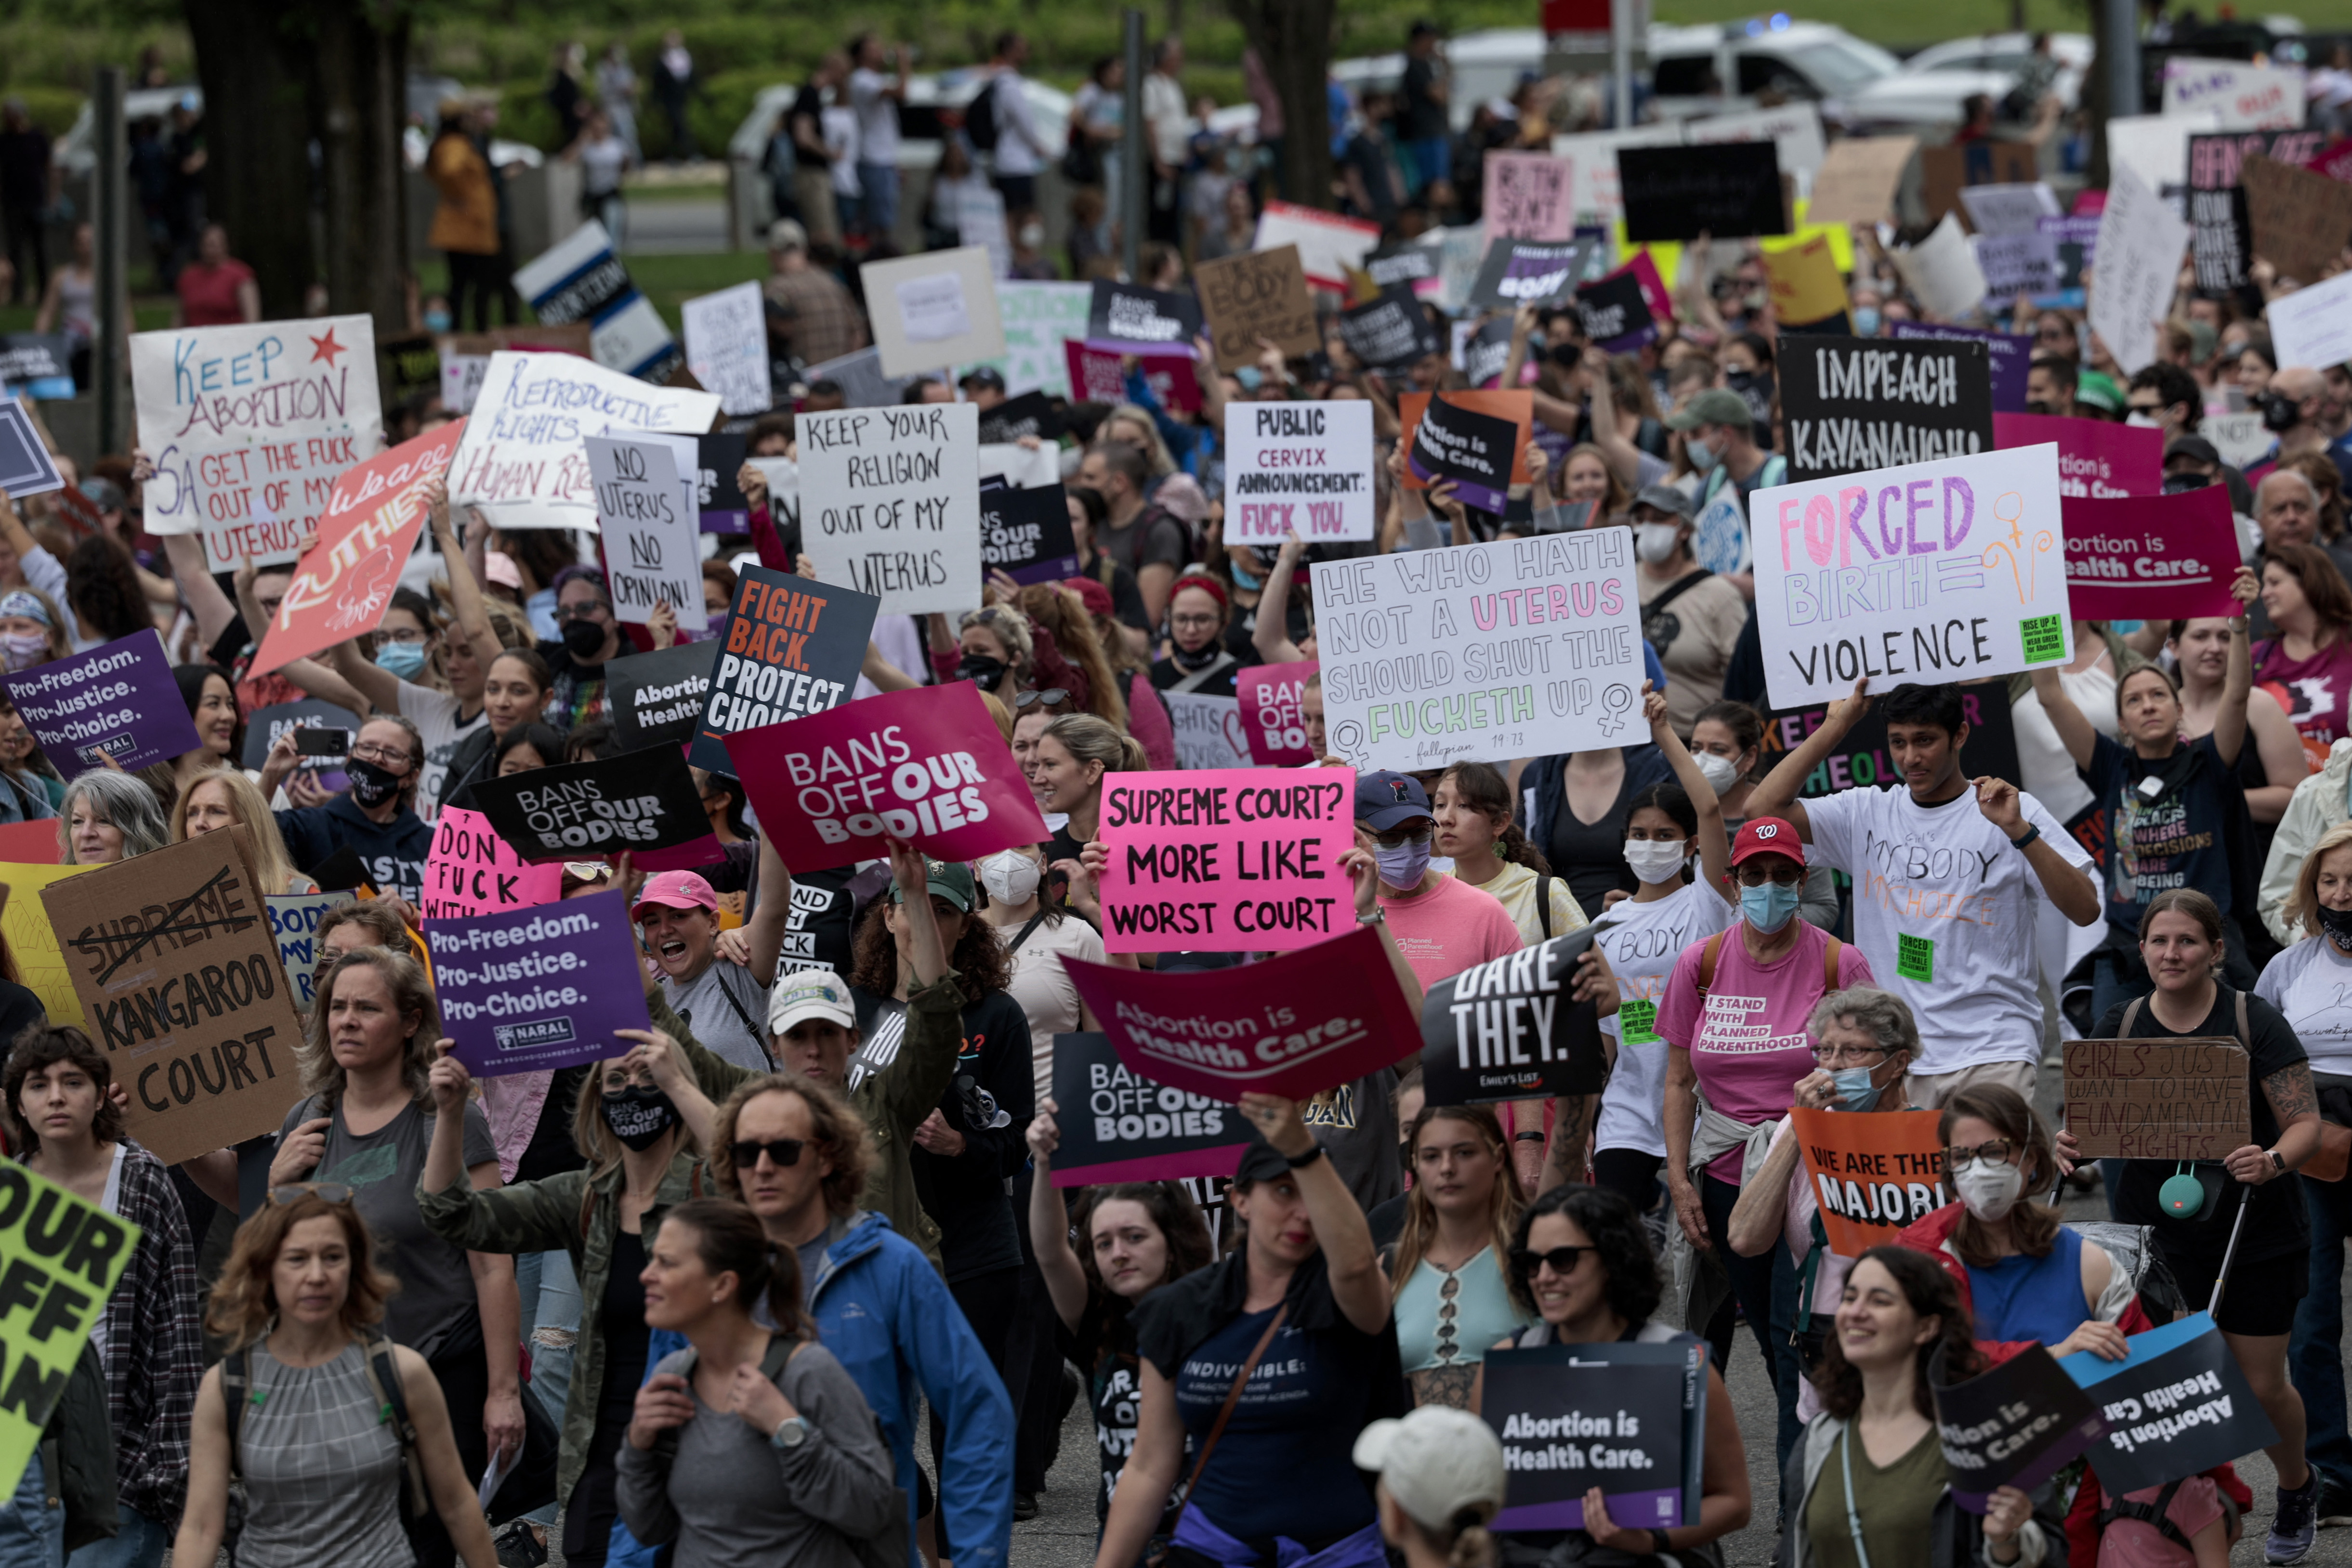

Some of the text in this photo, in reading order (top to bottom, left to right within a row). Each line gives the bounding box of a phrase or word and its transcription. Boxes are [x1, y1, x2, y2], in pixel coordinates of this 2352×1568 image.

[174, 336, 283, 405] KEEP
[1815, 348, 1957, 407] IMPEACH
[176, 366, 348, 437] ABORTION
[503, 358, 679, 428] REPRODUCTIVE
[487, 408, 579, 445] RIGHTS
[806, 415, 869, 452] KEEP
[882, 408, 949, 441] YOUR
[1257, 408, 1326, 436] PUBLIC
[200, 434, 358, 487] GET THE FUCK
[1257, 448, 1326, 467] CERVIX
[1448, 449, 1495, 475] Care.
[1472, 435, 1487, 454] is
[459, 444, 546, 500] HUMAN
[613, 447, 645, 480] NO
[848, 447, 942, 488] RELIGION
[208, 480, 292, 521] OUT OF
[599, 482, 674, 524] UTERUS
[822, 496, 950, 536] OUT OF MY
[1241, 501, 1348, 536] FUCK YOU.
[211, 513, 300, 562] UTERUS
[990, 523, 1042, 547] OUR
[1778, 476, 1974, 572] FORCED
[2144, 532, 2165, 552] is
[629, 530, 661, 565] NO
[848, 549, 947, 596] UTERUS
[1320, 531, 1624, 608] HE WHO HATH
[2134, 556, 2210, 578] Care.
[613, 571, 692, 611] OPINION!
[738, 579, 828, 633] FIGHT
[1784, 555, 1927, 627] BIRTH
[1328, 578, 1623, 655] NOT A UTERUS
[2023, 616, 2057, 631] RISE UP 4
[726, 616, 810, 672] BACK.
[1789, 617, 1992, 686] VIOLENCE
[2026, 634, 2058, 646] WEAR GREEN
[2037, 642, 2060, 652] Abortion
[8, 650, 142, 699] Pro-Freedom.
[1327, 625, 1632, 704] SHOULD SHUT THE
[21, 681, 137, 723] Pro-Justice.
[716, 653, 845, 715] PROTECT
[35, 708, 143, 745] Pro-Choice.
[1368, 684, 1535, 744] FUCKETH
[1547, 678, 1592, 717] UP
[784, 725, 910, 786] BANS
[1417, 732, 1524, 766] fallopian 19:73
[516, 779, 602, 813] BANS
[798, 751, 986, 818] OFF OUR
[527, 795, 665, 833] OFF OUR
[812, 786, 989, 845] BODIES
[1107, 782, 1343, 827] SUPREME COURT?
[537, 819, 659, 849] BODIES
[2133, 820, 2189, 843] WHERE
[2134, 832, 2213, 857] DECISIONS
[1126, 838, 1325, 885] MORE LIKE
[1906, 846, 1999, 884] BODY
[2138, 857, 2167, 873] ARE
[439, 862, 519, 904] FUCK
[2136, 872, 2185, 889] BEING
[1108, 897, 1336, 935] WORST COURT
[1889, 885, 1998, 926] CHOICE
[77, 877, 253, 975] SUPREME
[430, 913, 599, 953] Pro-Freedom.
[1619, 926, 1685, 963] BODY
[1901, 934, 1928, 951] FORCED
[281, 939, 313, 965] MY
[436, 950, 588, 987] Pro-Justice.
[1453, 936, 1561, 1002] DARE
[1906, 954, 1928, 966] FEMALE
[93, 953, 275, 1051] KANGAROO
[442, 985, 588, 1021] Pro-Choice.
[1116, 1000, 1296, 1039] Abortion is
[1621, 1001, 1647, 1013] RISE UP
[1707, 1011, 1743, 1024] WITH
[1708, 997, 1763, 1010] I STAND
[516, 1020, 568, 1039] NARAL
[1123, 1016, 1363, 1068] Health Care.
[1449, 995, 1569, 1070] THEY.
[1625, 1019, 1639, 1028] WEAR
[1704, 1025, 1768, 1037] PLANNED
[1699, 1036, 1803, 1052] PARENTHOOD
[2068, 1043, 2231, 1078] GIRLS JUST
[138, 1025, 276, 1112] COURT
[1518, 1072, 1539, 1083] LIST
[1090, 1087, 1153, 1116] OFF
[2070, 1076, 2243, 1099] WANT TO HAVE
[609, 1100, 641, 1114] BANS
[609, 1106, 664, 1125] OFF OUR
[1094, 1109, 1224, 1142] BODIES
[2067, 1100, 2248, 1137] FUNDAMENTAL
[613, 1118, 660, 1137] BODIES
[1810, 1145, 1942, 1176] WE ARE THE
[2119, 1134, 2215, 1159] RIGHTS
[2142, 1370, 2221, 1413] Health
[1502, 1409, 1639, 1439] Abortion is
[1999, 1400, 2029, 1424] is
[2109, 1395, 2234, 1454] Abortion is
[1986, 1412, 2062, 1461] Care.
[1502, 1443, 1654, 1471] Health Care.
